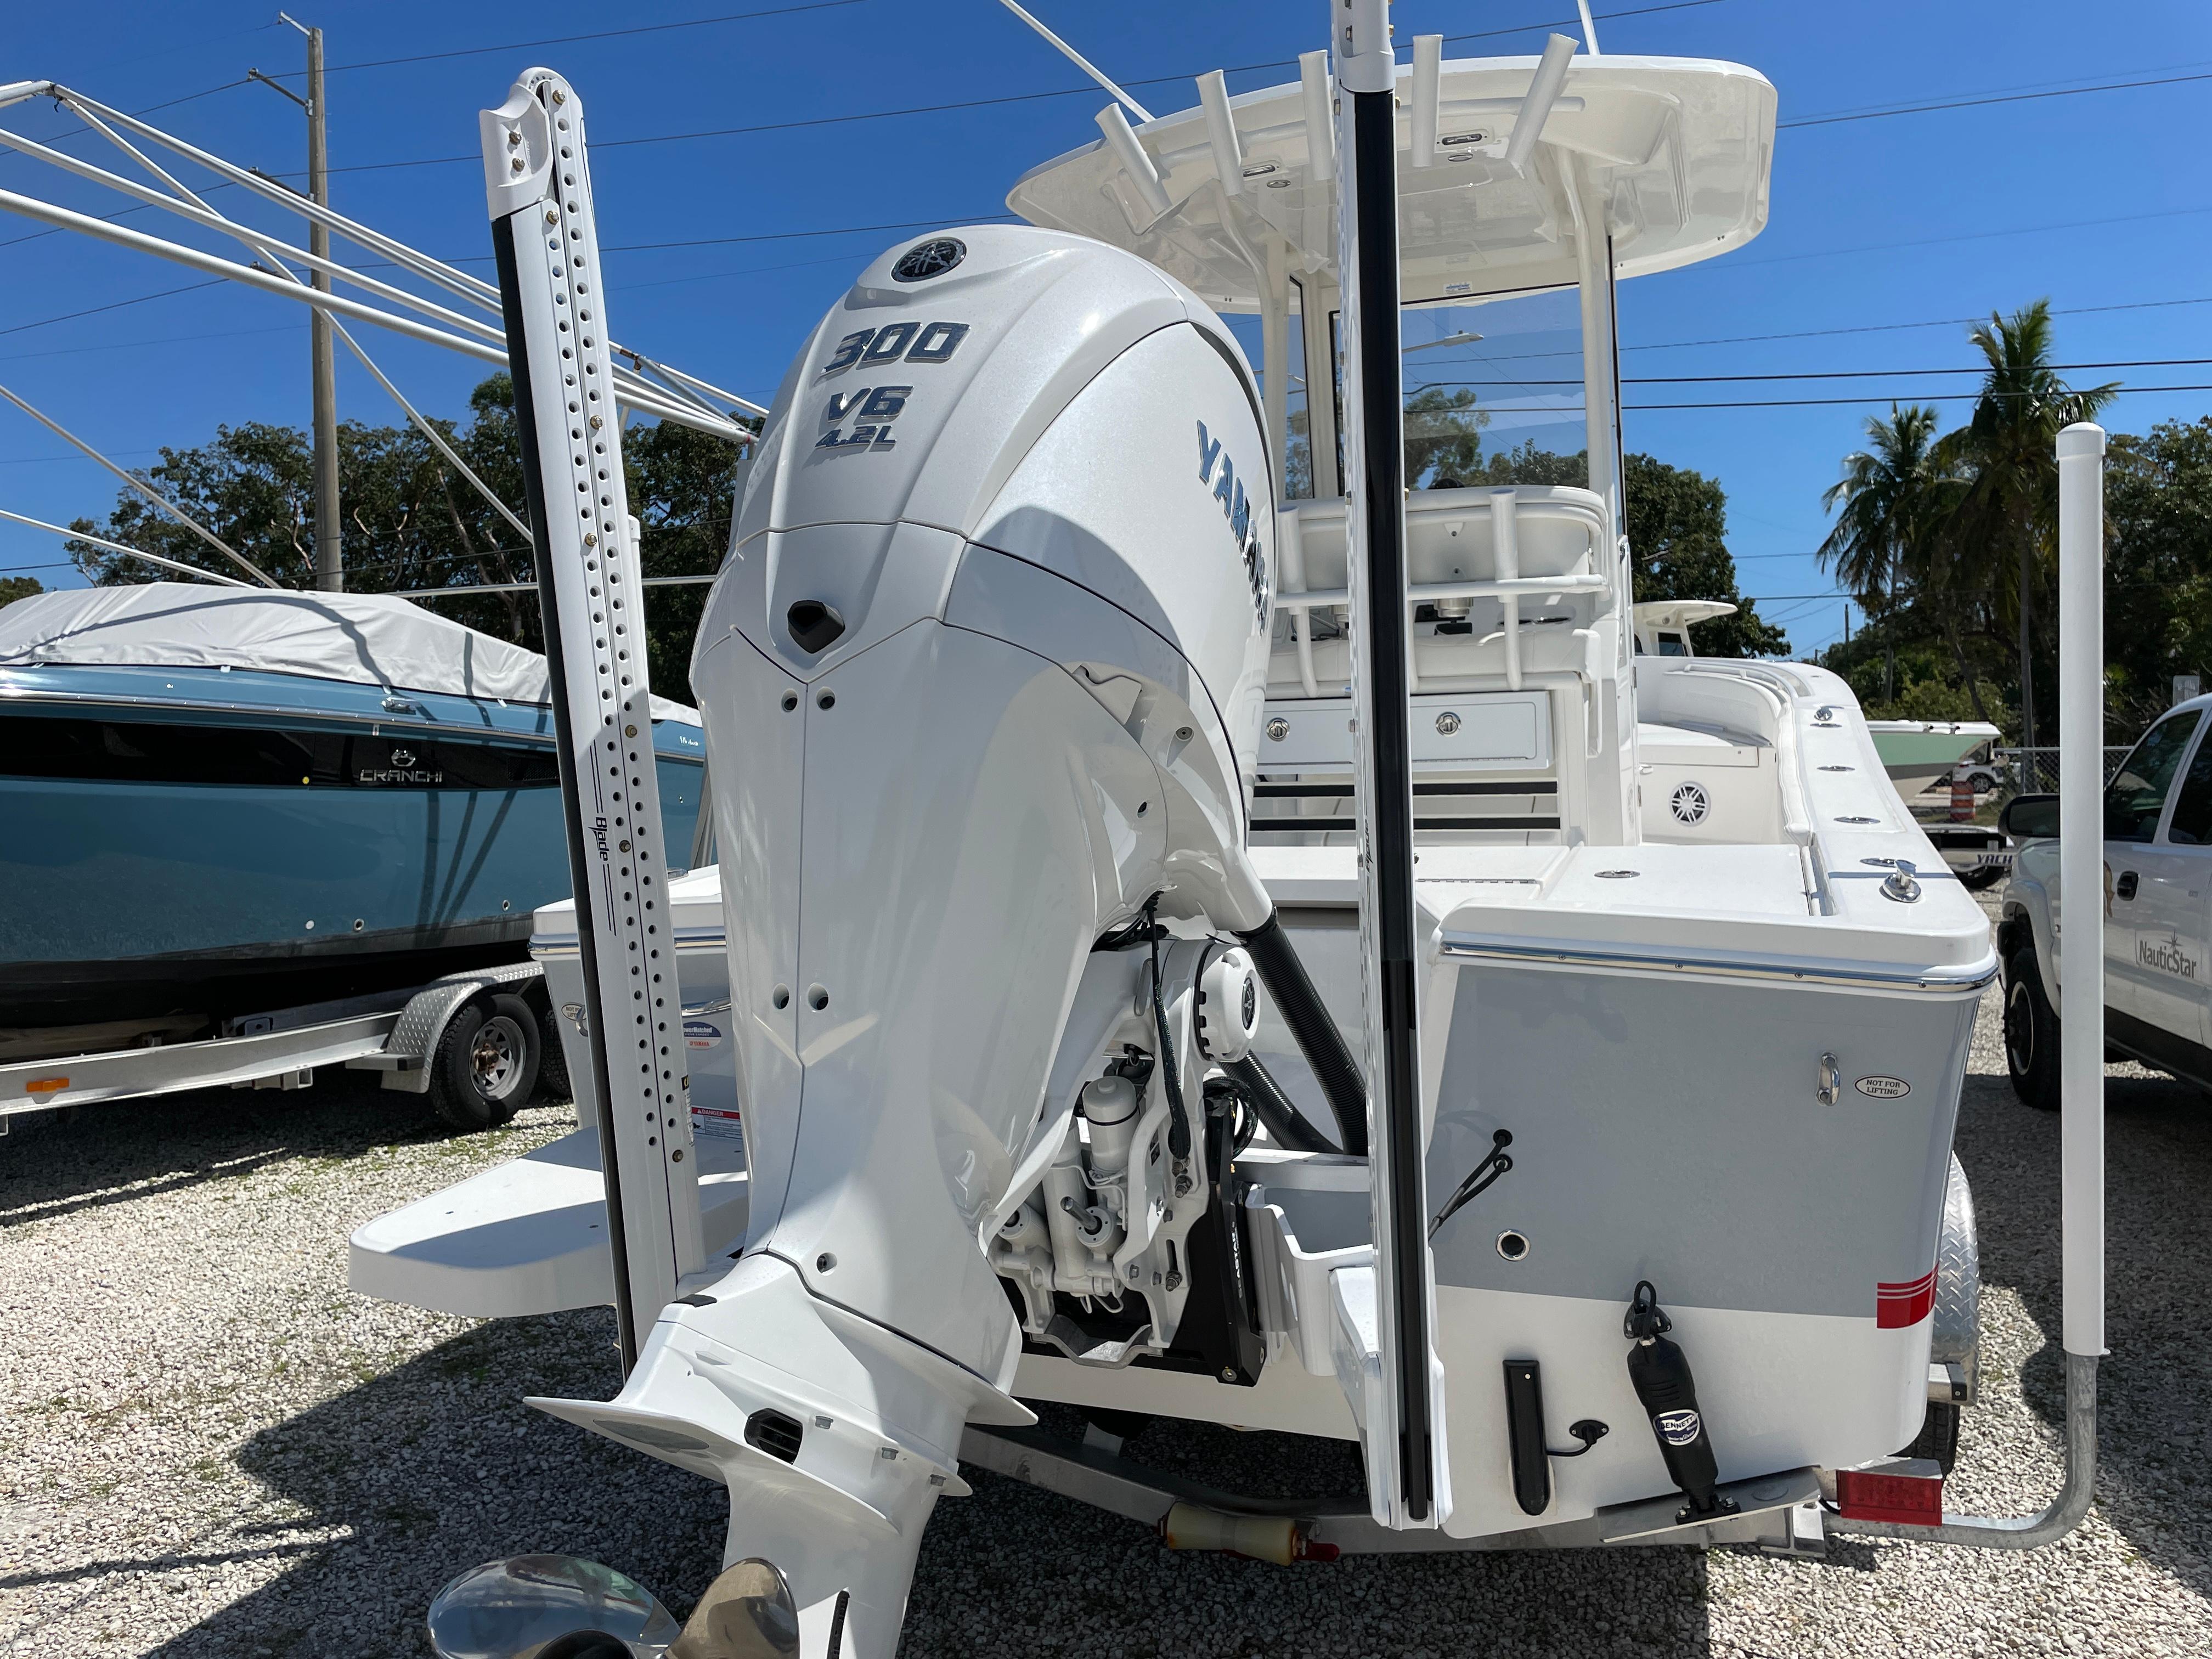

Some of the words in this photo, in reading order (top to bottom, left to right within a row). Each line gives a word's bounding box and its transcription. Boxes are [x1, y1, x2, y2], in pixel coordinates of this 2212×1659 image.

[820, 321, 972, 377] 300
[827, 385, 915, 422] V6
[814, 425, 898, 449] 4.2L
[1197, 419, 1268, 637] YAMAHA
[359, 769, 443, 783] CRANCHI
[588, 816, 610, 861] Blade
[2139, 939, 2197, 979] NauticStar
[1866, 1086, 1898, 1096] LIFTING
[1884, 1080, 1900, 1088] FOR
[702, 1109, 724, 1117] DANGER
[1661, 1417, 1692, 1429] BENNETT
